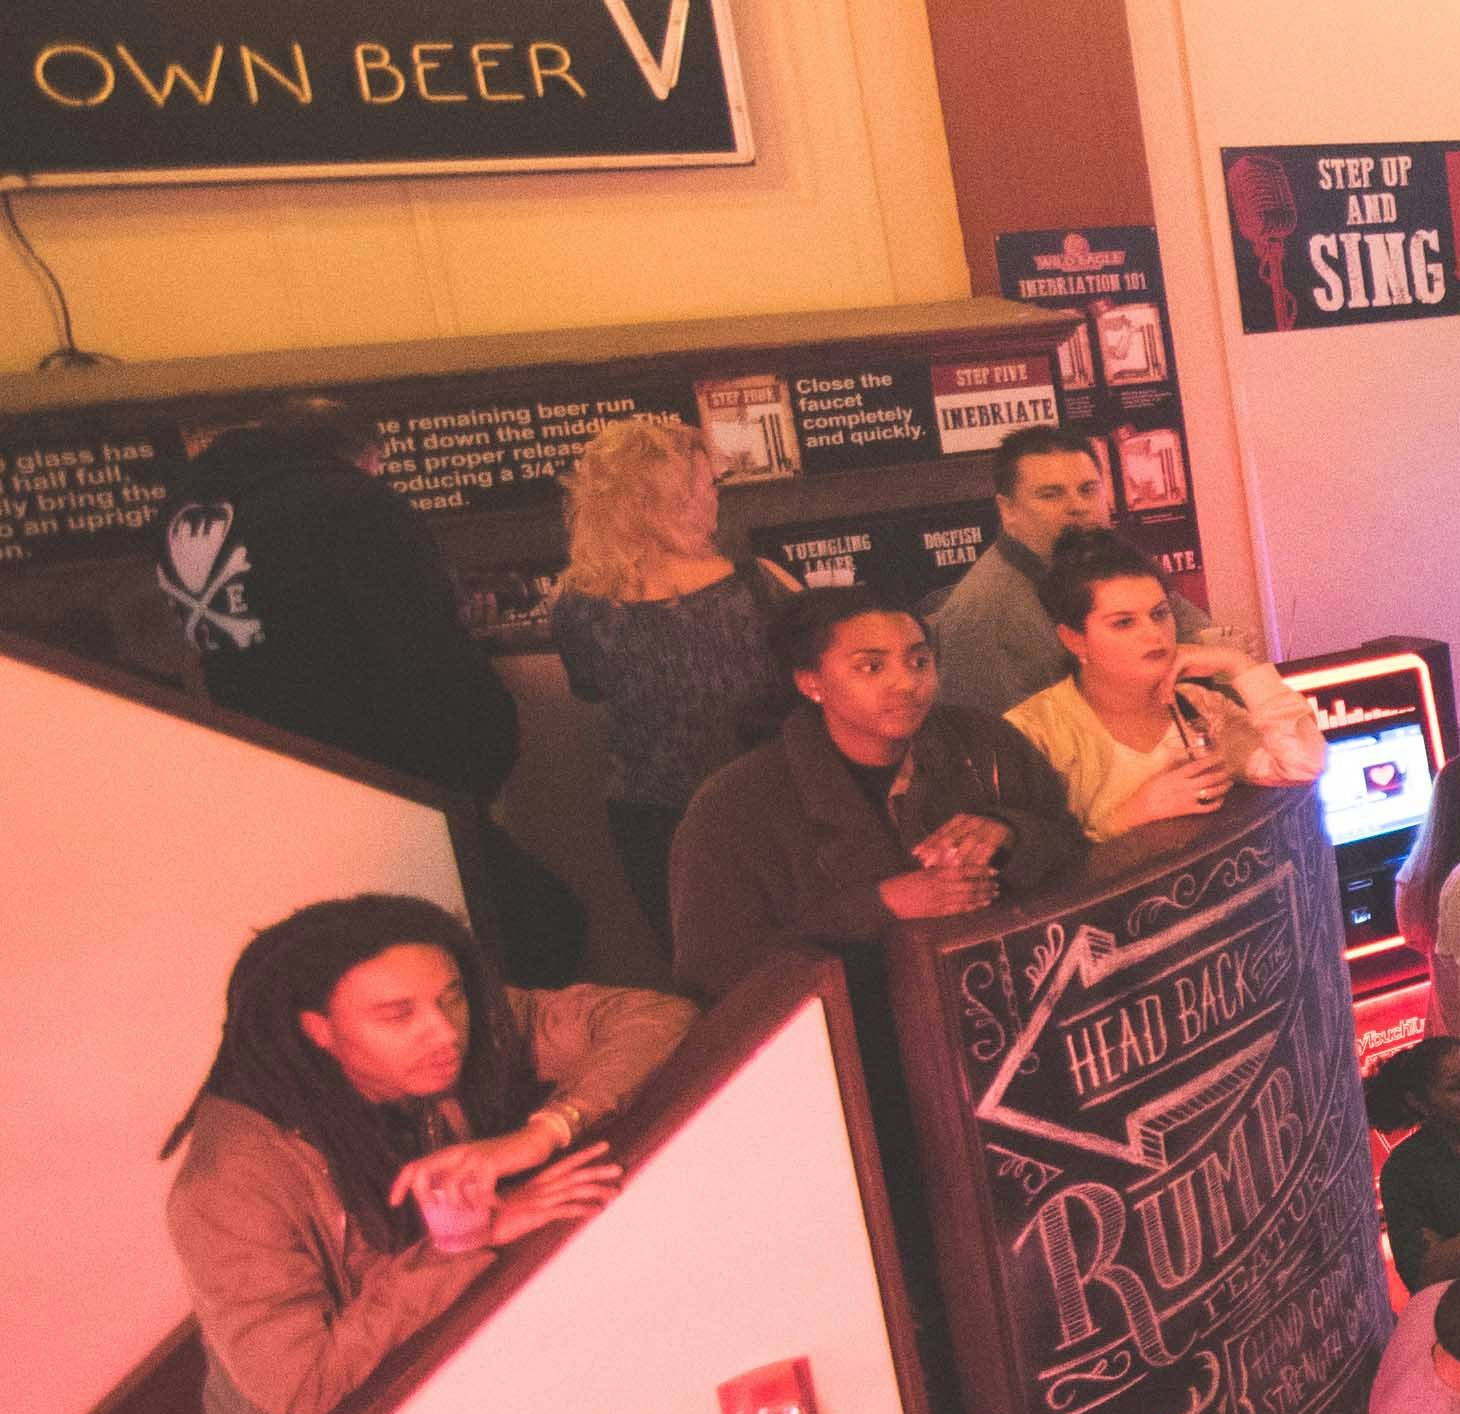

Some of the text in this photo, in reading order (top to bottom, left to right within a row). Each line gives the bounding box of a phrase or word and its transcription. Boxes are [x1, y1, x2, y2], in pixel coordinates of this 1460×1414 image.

[34, 41, 587, 108] OWN BEER
[1318, 155, 1412, 190] STEP UP
[1346, 193, 1397, 225] AND
[1018, 271, 1148, 298] INEBRIATION 101
[1309, 228, 1446, 312] SING
[796, 373, 893, 395] Close the
[956, 364, 1028, 387] STEP FIVE
[408, 408, 532, 431] remaining
[538, 402, 590, 418] beer
[596, 398, 635, 413] run
[799, 391, 864, 411] faucet
[940, 398, 1056, 431] INEBRIATE
[802, 406, 913, 430] completely
[423, 431, 490, 449] down
[497, 425, 535, 443] the
[542, 418, 620, 439] middl
[805, 424, 927, 449] and quickly.
[16, 444, 154, 474] glass has
[425, 449, 505, 473] proper
[513, 439, 596, 460] releas
[12, 471, 66, 492] half
[391, 469, 493, 494] oducing
[500, 468, 514, 482] a
[37, 492, 114, 513] bring
[123, 484, 167, 502] the
[24, 518, 59, 537] an
[923, 526, 983, 550] DOGFISH
[783, 533, 872, 562] YUENGLING
[936, 545, 977, 567] HEAD
[1066, 994, 1168, 1095] HEAD
[1174, 943, 1257, 1045] BACK
